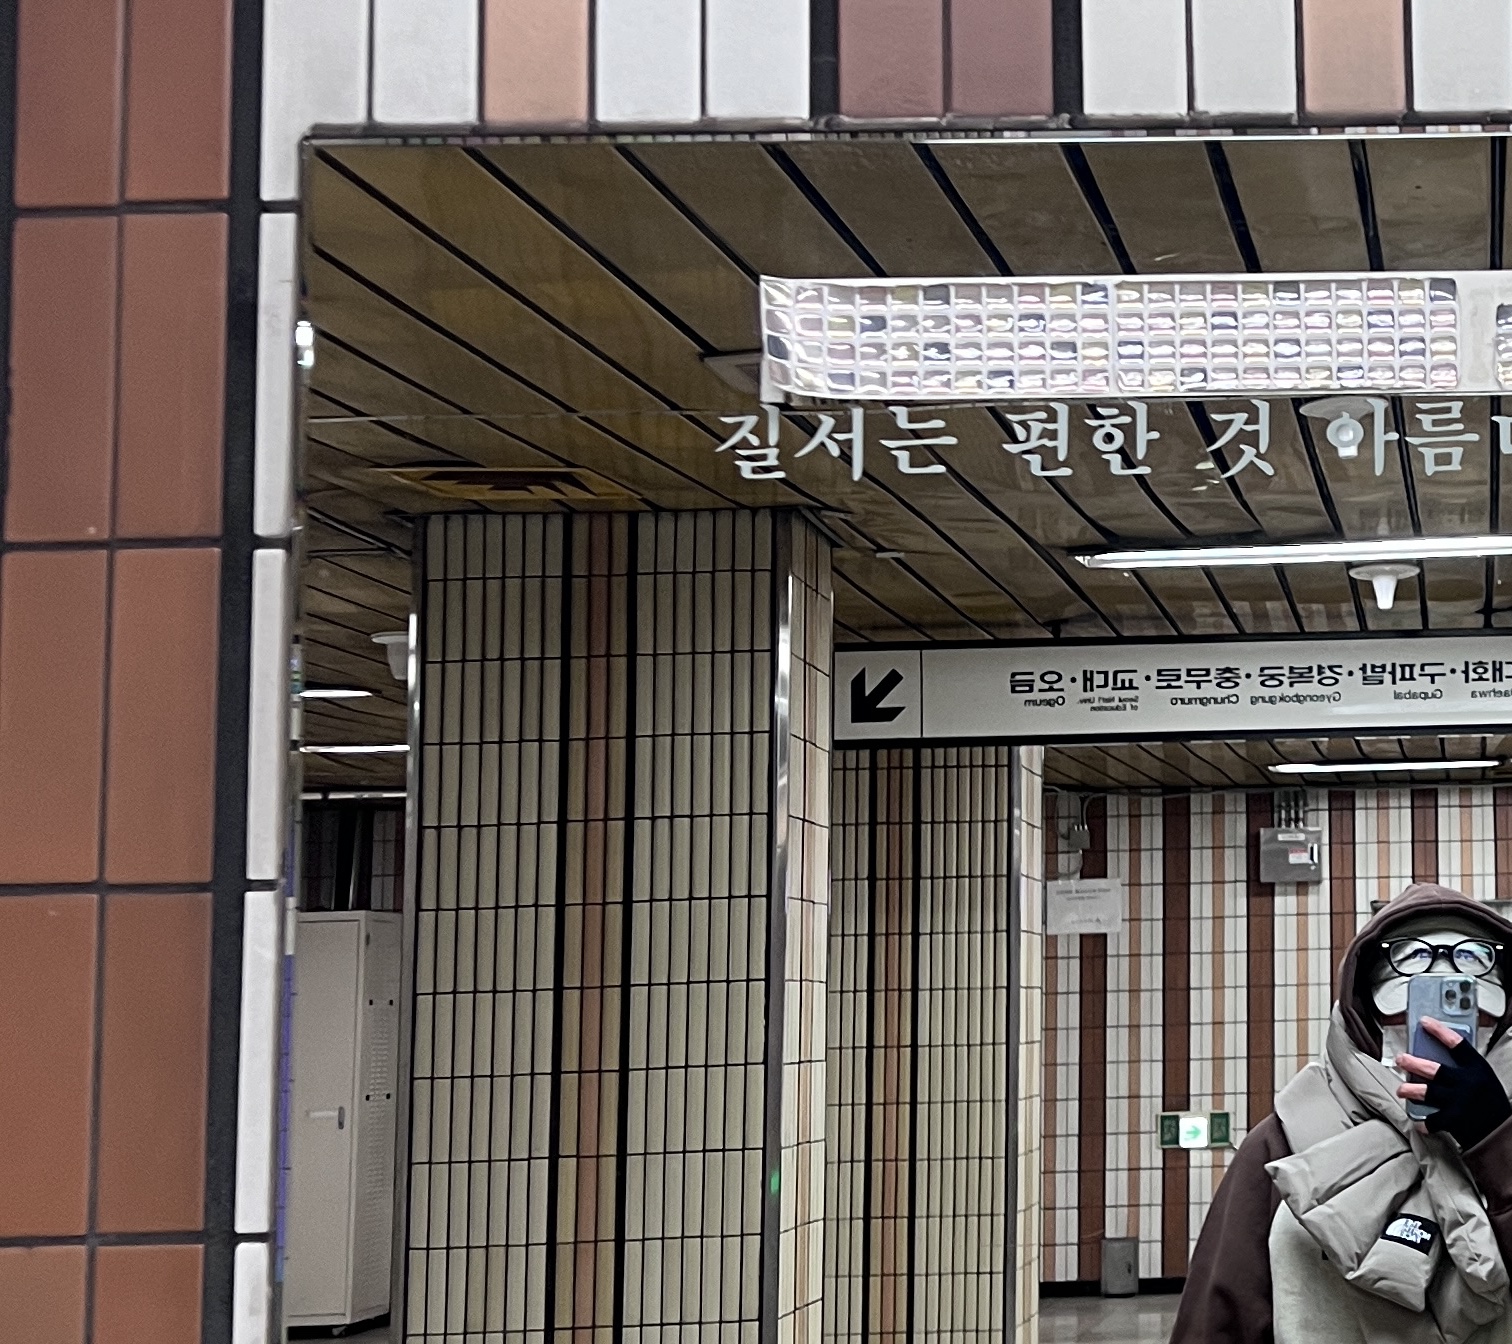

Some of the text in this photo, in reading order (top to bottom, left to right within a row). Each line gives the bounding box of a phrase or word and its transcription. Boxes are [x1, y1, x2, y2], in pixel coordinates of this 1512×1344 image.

[714, 403, 958, 481] 질서는
[1002, 401, 1160, 477] 편한
[1208, 400, 1276, 478] 것
